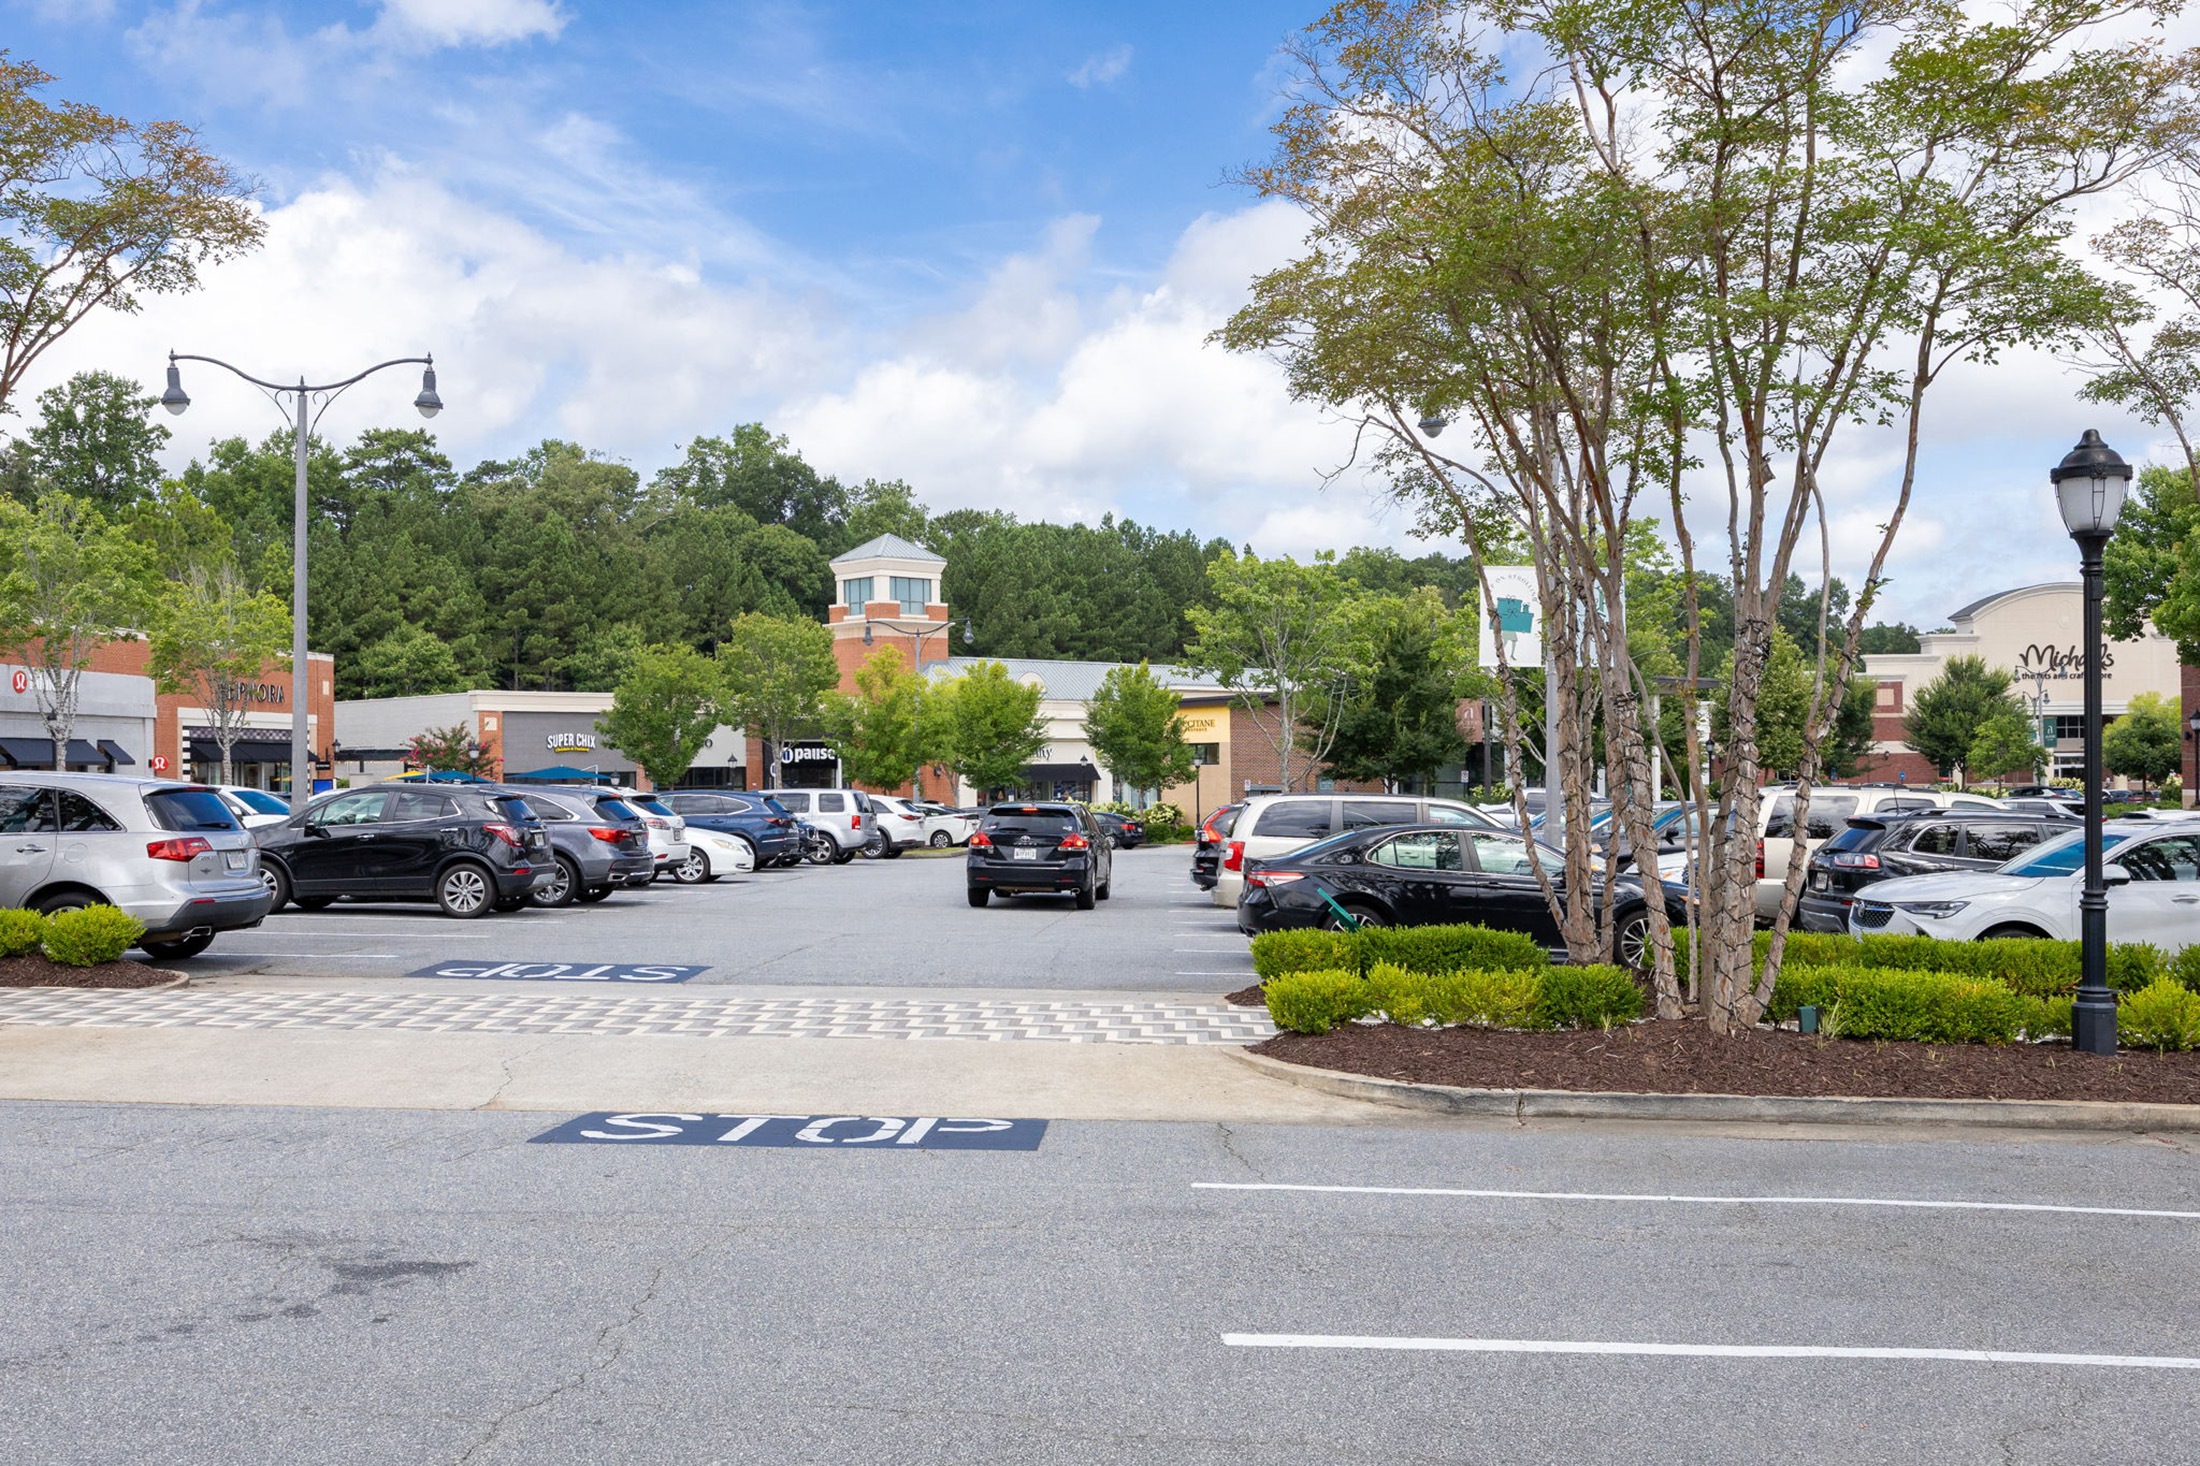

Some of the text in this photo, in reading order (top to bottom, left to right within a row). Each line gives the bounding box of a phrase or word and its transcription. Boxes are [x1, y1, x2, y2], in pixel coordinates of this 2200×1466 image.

[220, 682, 285, 704] EPHORA
[547, 733, 596, 749] SUPER CHIX
[436, 963, 689, 981] STOP
[580, 1113, 1014, 1144] STOP
